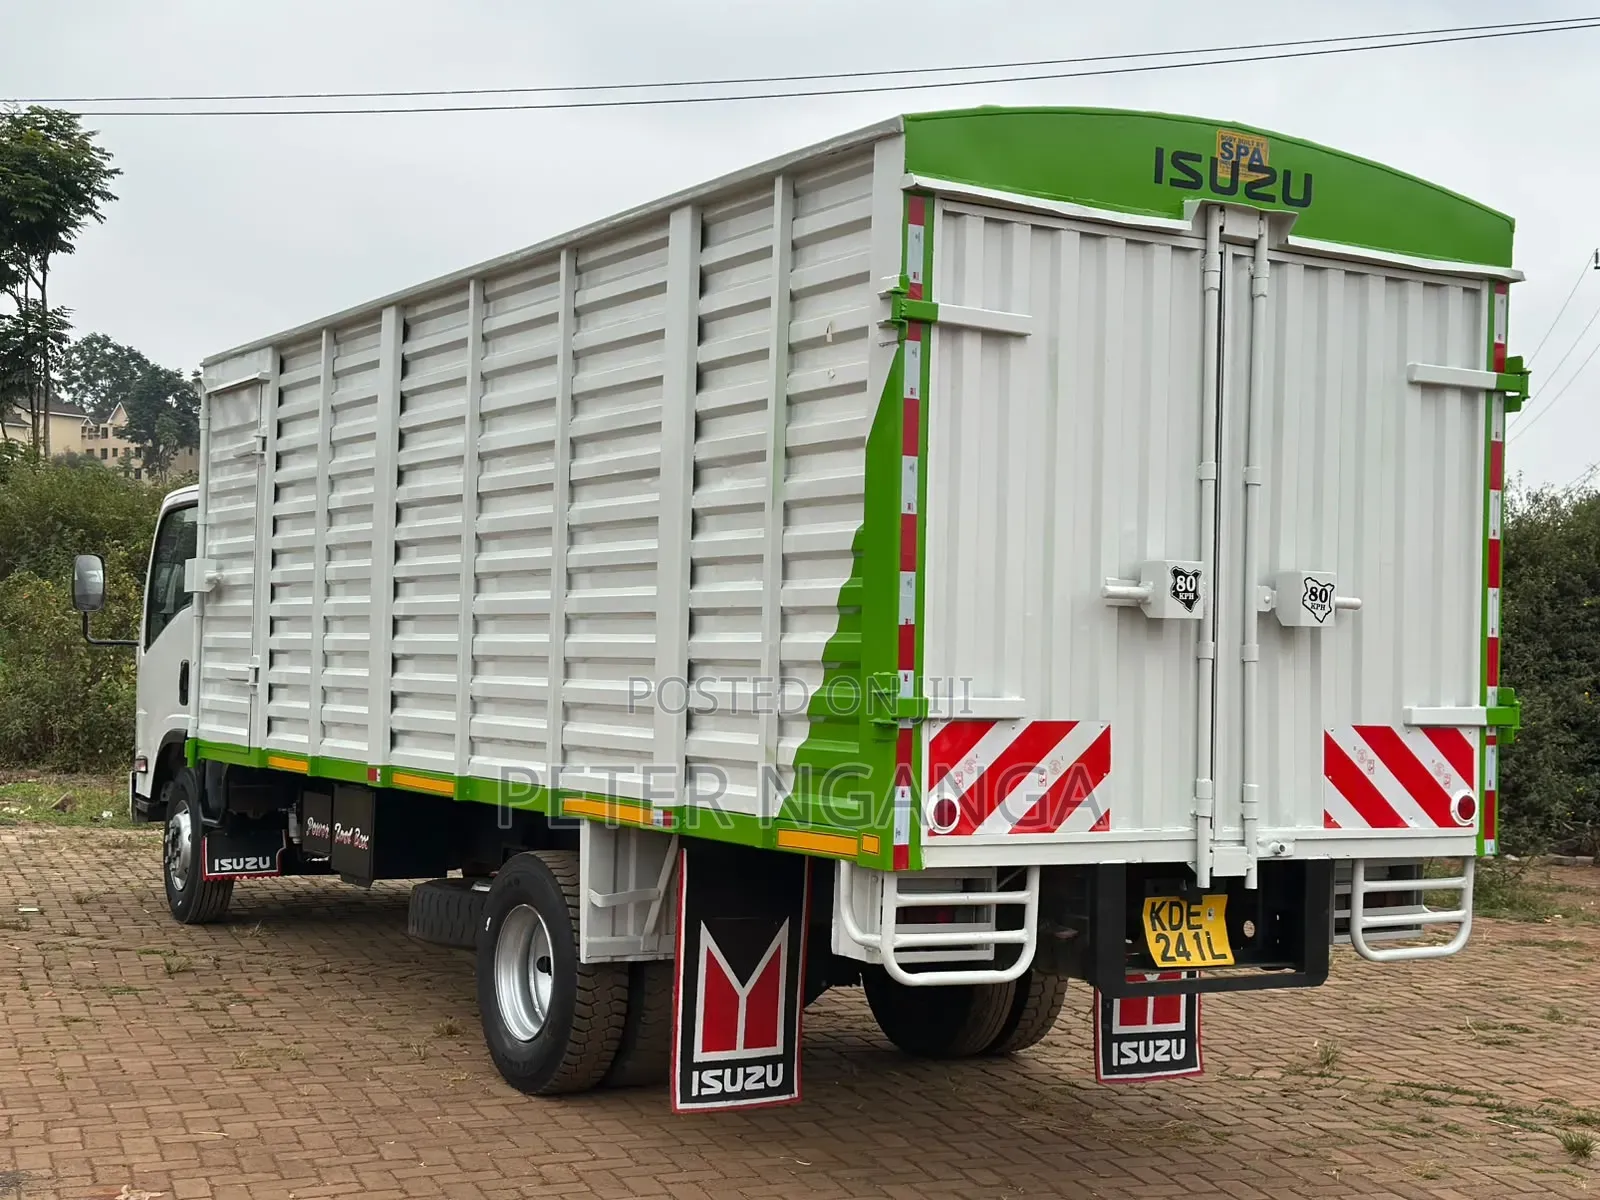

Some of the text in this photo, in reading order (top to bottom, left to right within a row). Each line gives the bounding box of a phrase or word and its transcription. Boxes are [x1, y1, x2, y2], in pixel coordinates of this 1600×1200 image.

[1220, 142, 1266, 167] SPA
[1154, 147, 1313, 207] ISUZU
[1176, 575, 1196, 592] 80
[1179, 592, 1195, 600] KPH
[1308, 586, 1329, 603] 80
[1310, 602, 1326, 611] KPH
[214, 856, 271, 871] ISUZU
[1150, 900, 1203, 931] KDE
[1155, 930, 1228, 962] 241L
[1112, 1038, 1186, 1066] ISUZU
[691, 1063, 784, 1097] ISUZU
